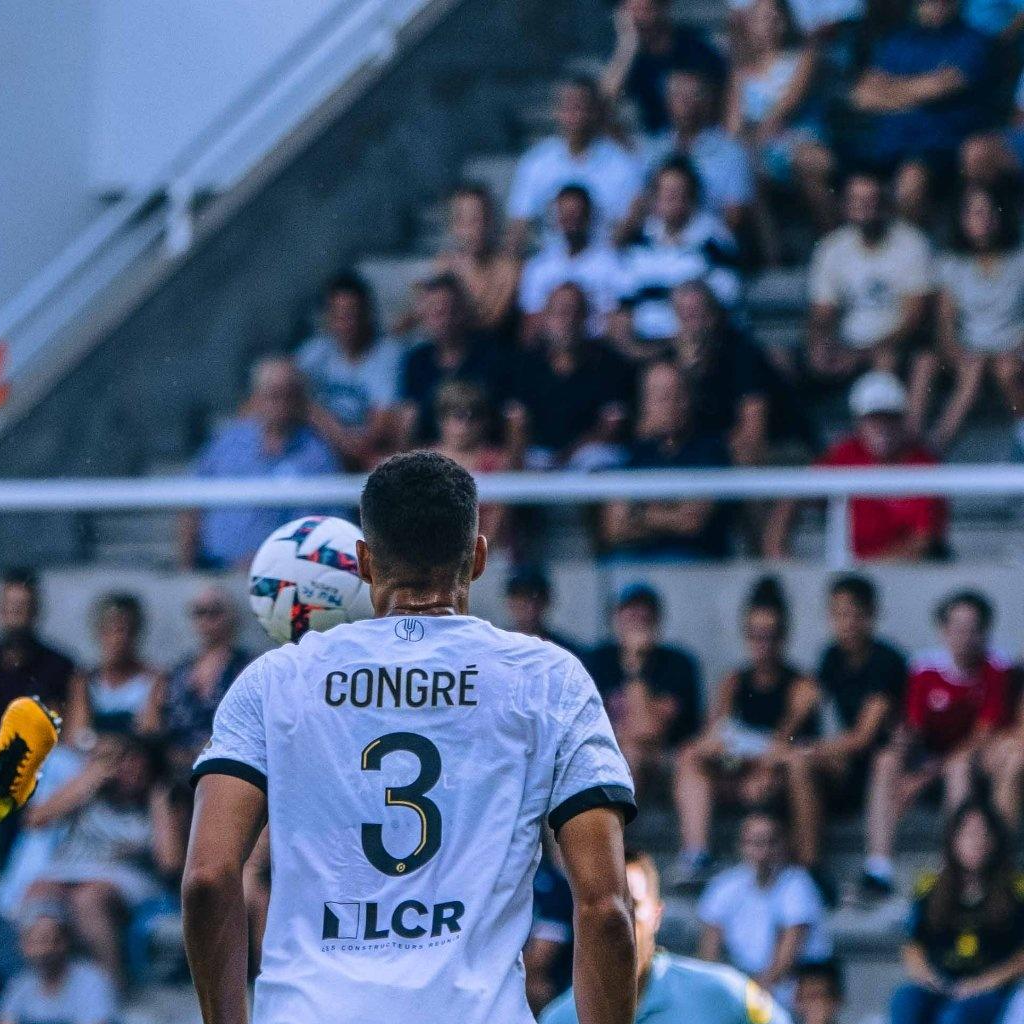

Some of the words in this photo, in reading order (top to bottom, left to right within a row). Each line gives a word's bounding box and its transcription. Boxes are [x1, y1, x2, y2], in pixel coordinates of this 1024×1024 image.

[325, 664, 479, 708] CONGRÉ
[361, 731, 442, 877] 3
[364, 900, 466, 940] LCR
[341, 941, 423, 951] CONSTRUCTEURS
